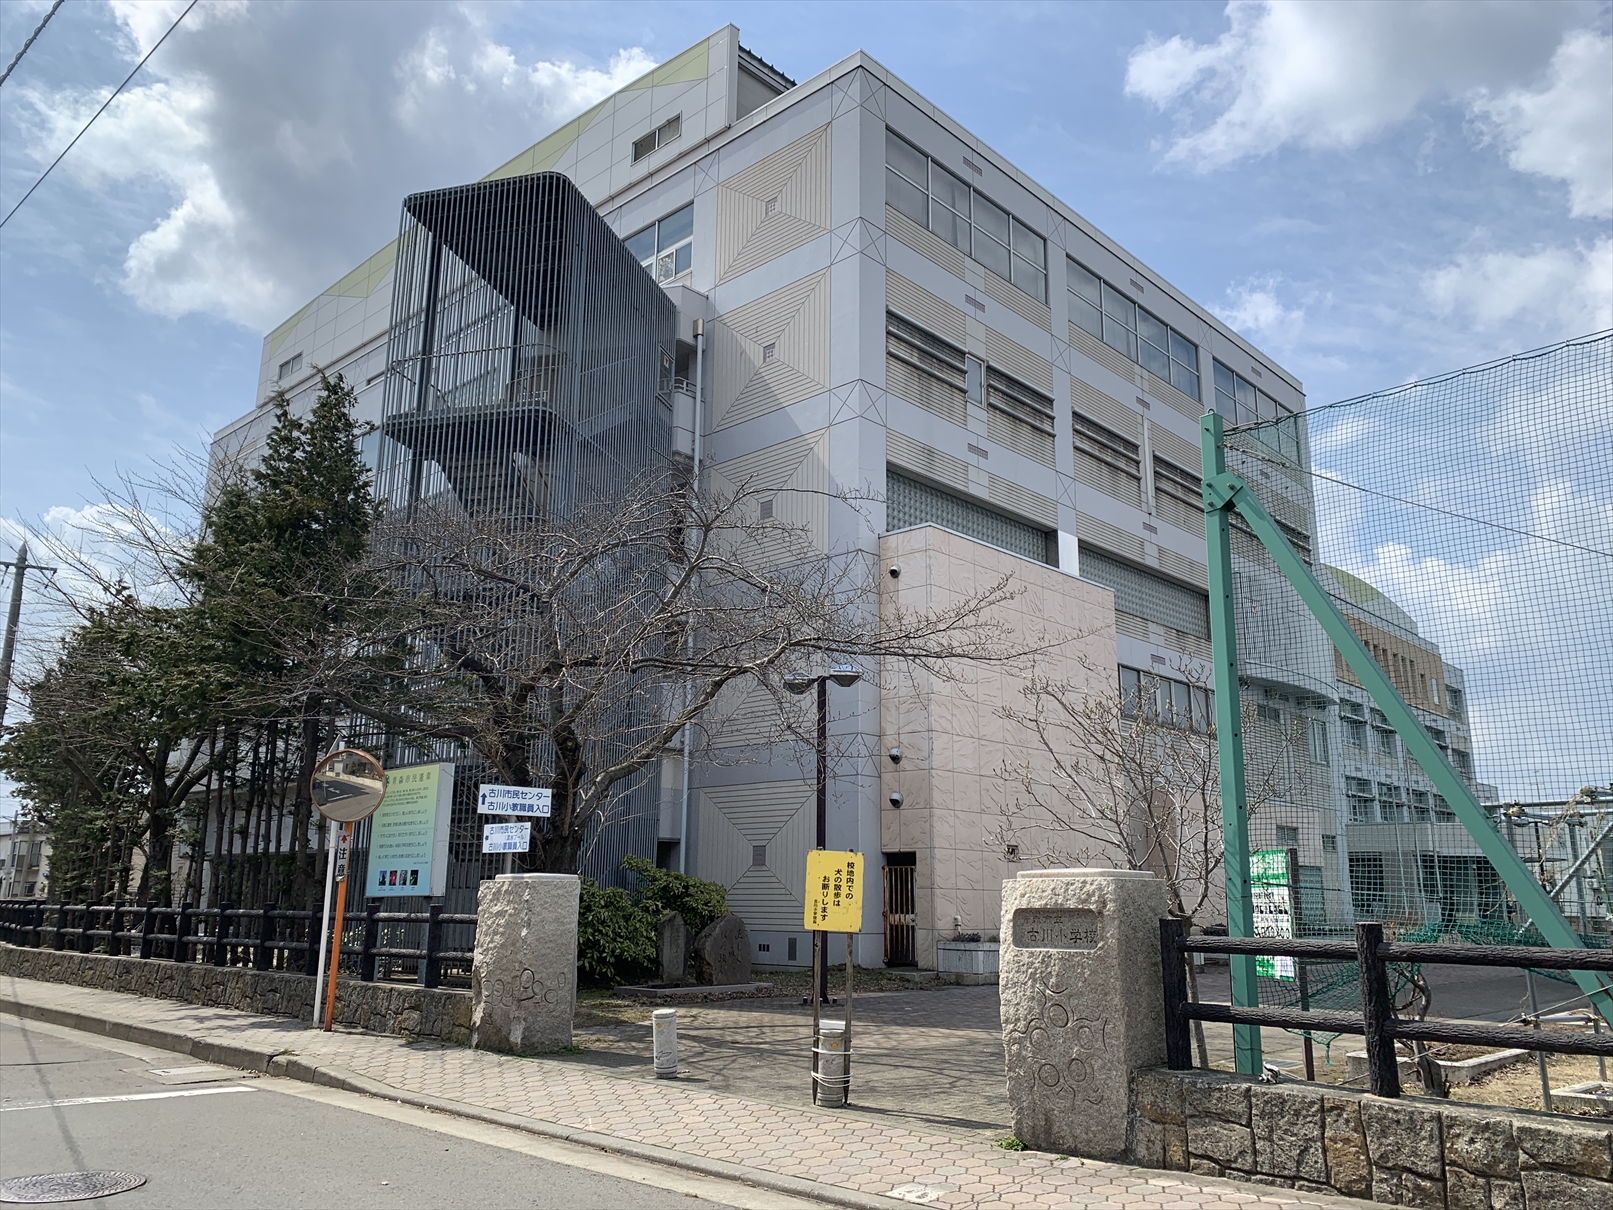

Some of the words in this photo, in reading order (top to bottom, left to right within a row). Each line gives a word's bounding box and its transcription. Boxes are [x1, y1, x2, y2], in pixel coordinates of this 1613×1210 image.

[488, 788, 550, 800] 古川市民センター
[487, 801, 549, 814] 古川小教職員入口
[489, 825, 529, 835] 古川市民センター
[337, 847, 348, 876] 注意
[833, 868, 843, 907] 犬の散歩は
[845, 861, 855, 900] 校地内での
[820, 875, 830, 922] お断りします
[1027, 927, 1098, 944] 古川小学校
